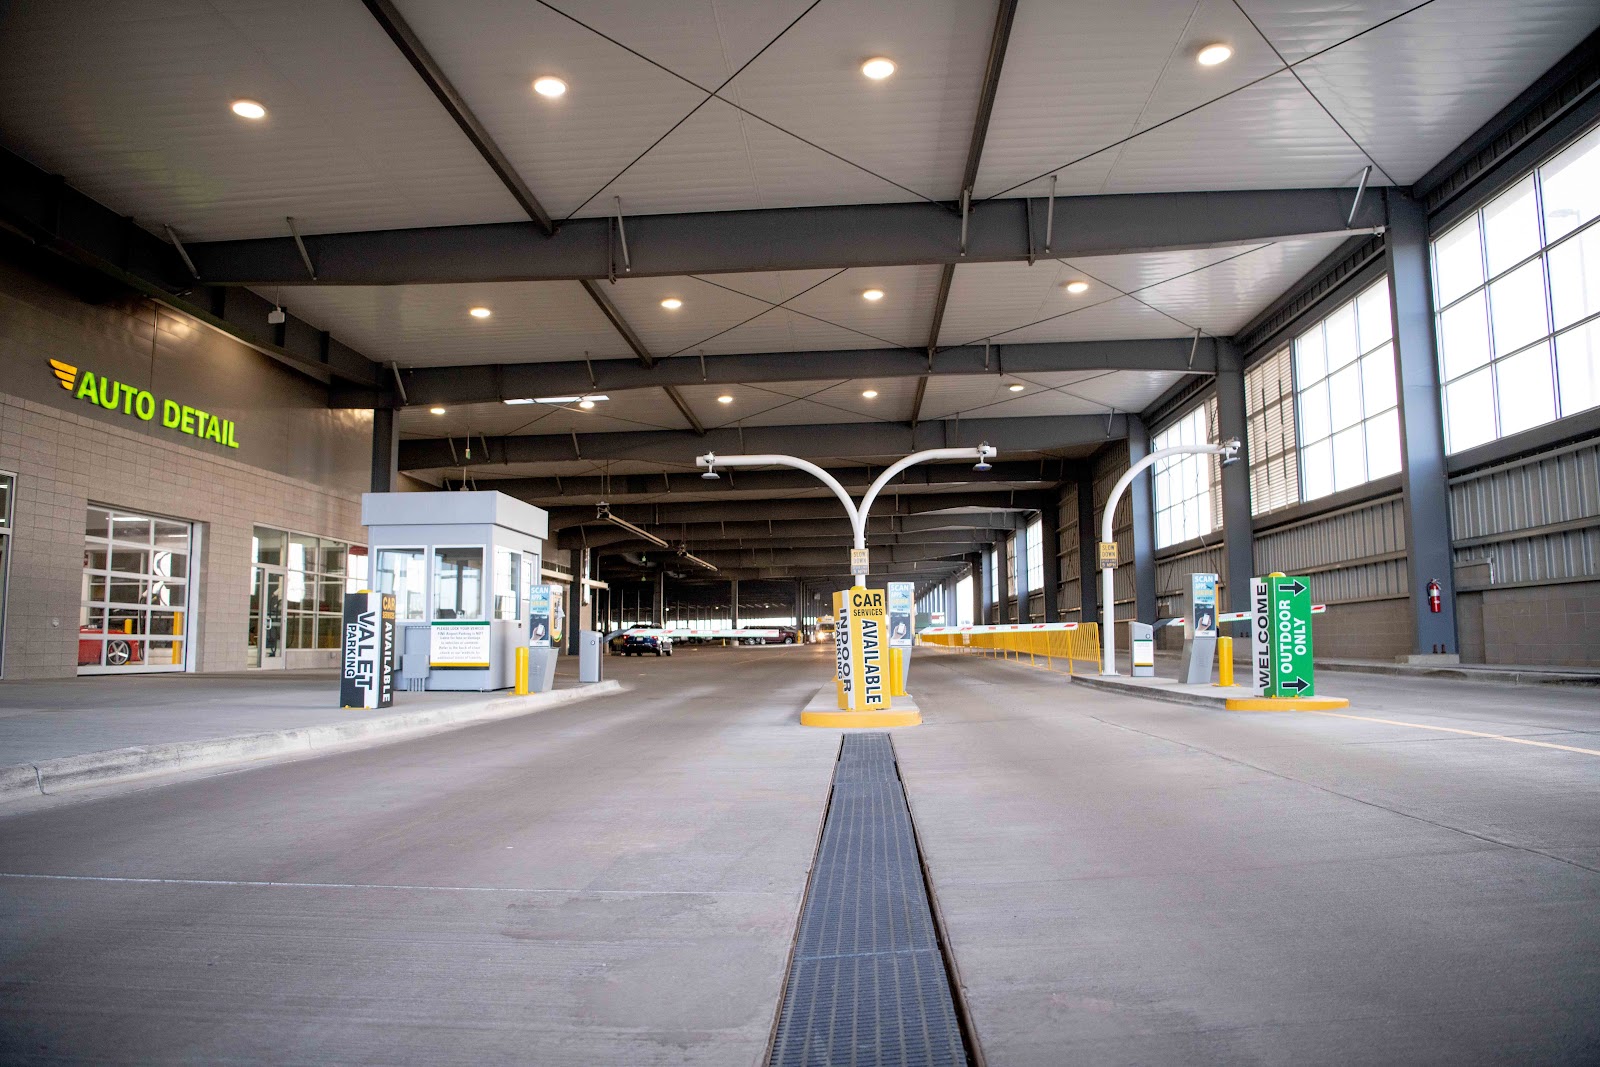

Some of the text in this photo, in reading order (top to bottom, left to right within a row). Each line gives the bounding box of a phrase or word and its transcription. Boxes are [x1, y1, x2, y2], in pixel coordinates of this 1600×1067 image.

[76, 371, 240, 449] AUTO DETAIL
[382, 596, 396, 611] CAR
[853, 593, 883, 607] CAR
[853, 608, 883, 617] SERVICES
[1256, 584, 1270, 688] WELCOME
[1279, 599, 1293, 674] OUTDOOR
[1293, 617, 1307, 656] ONLY
[346, 625, 357, 678] PARKING
[356, 611, 376, 691] VALET
[382, 621, 393, 703] AVAILABLE
[835, 622, 843, 680] PARKING
[840, 608, 852, 693] INDOOR
[862, 619, 882, 704] AVAILABLE
